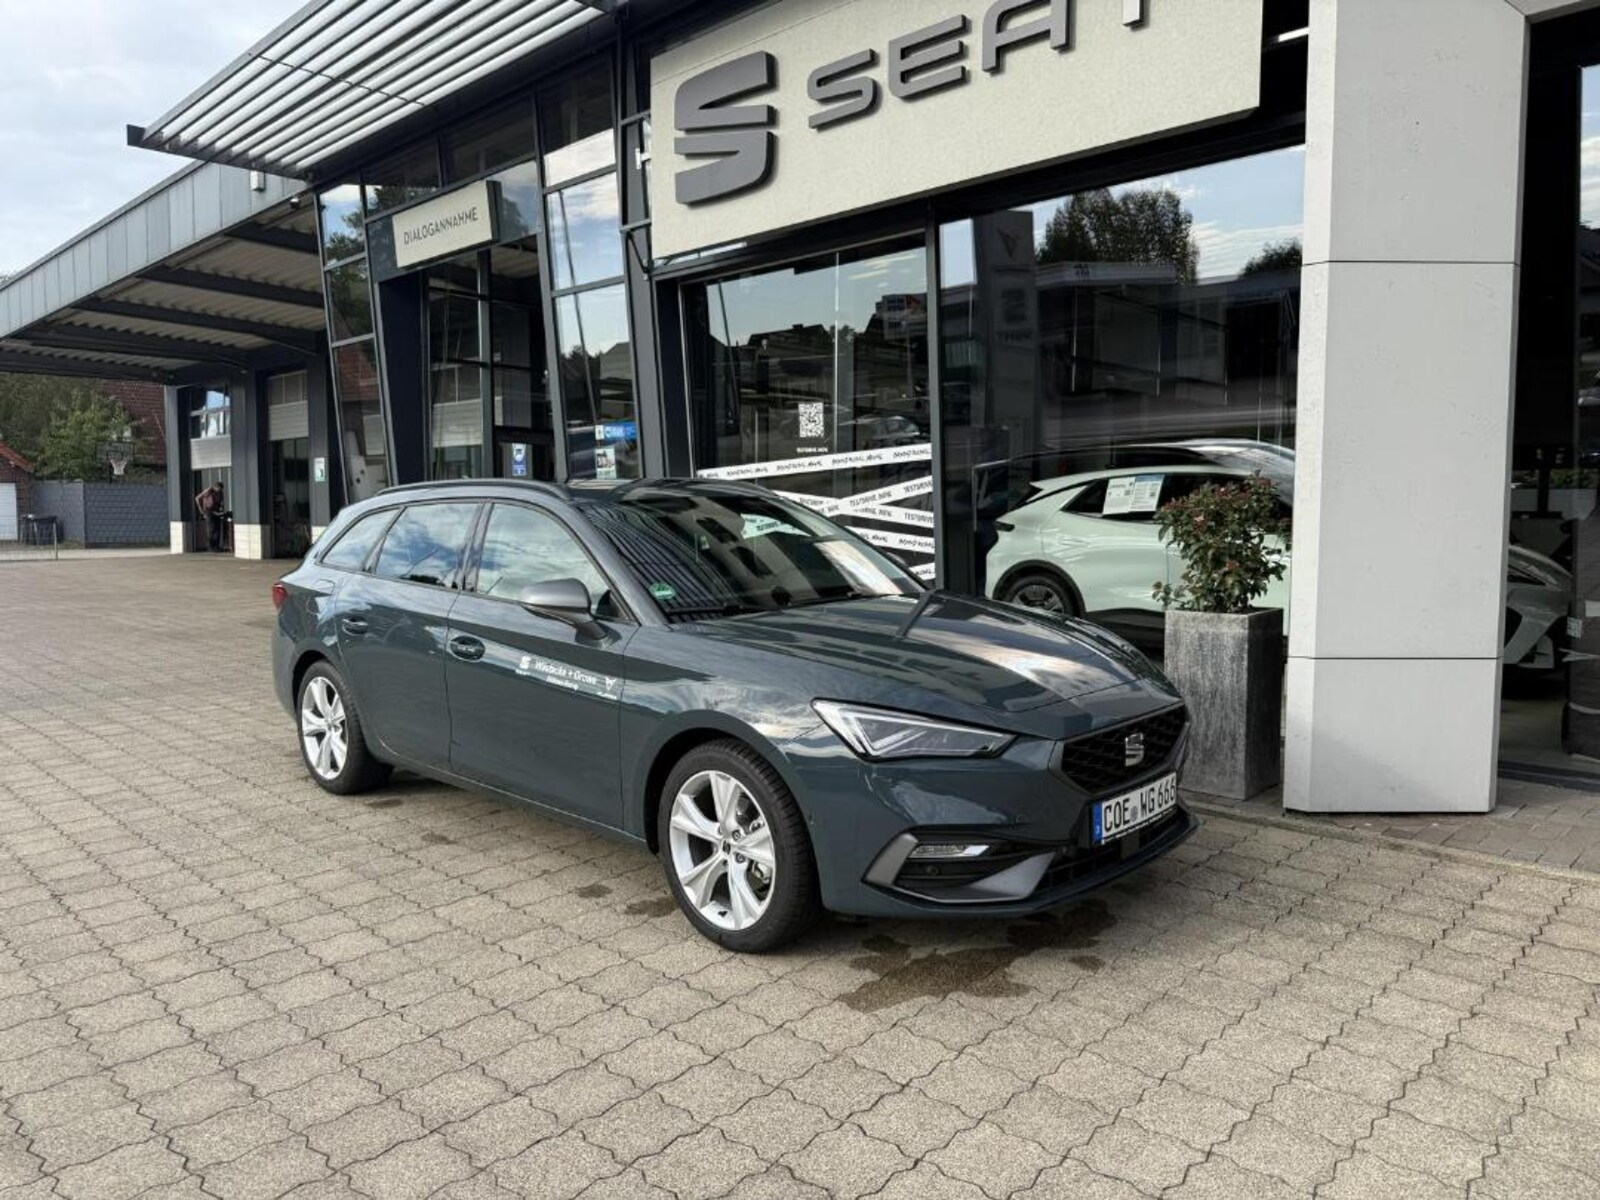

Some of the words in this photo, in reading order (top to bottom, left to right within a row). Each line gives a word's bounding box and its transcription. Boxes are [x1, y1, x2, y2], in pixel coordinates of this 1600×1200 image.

[403, 206, 479, 246] DIALOGANNAHME
[1103, 797, 1131, 833] COE
[1157, 777, 1176, 809] 666
